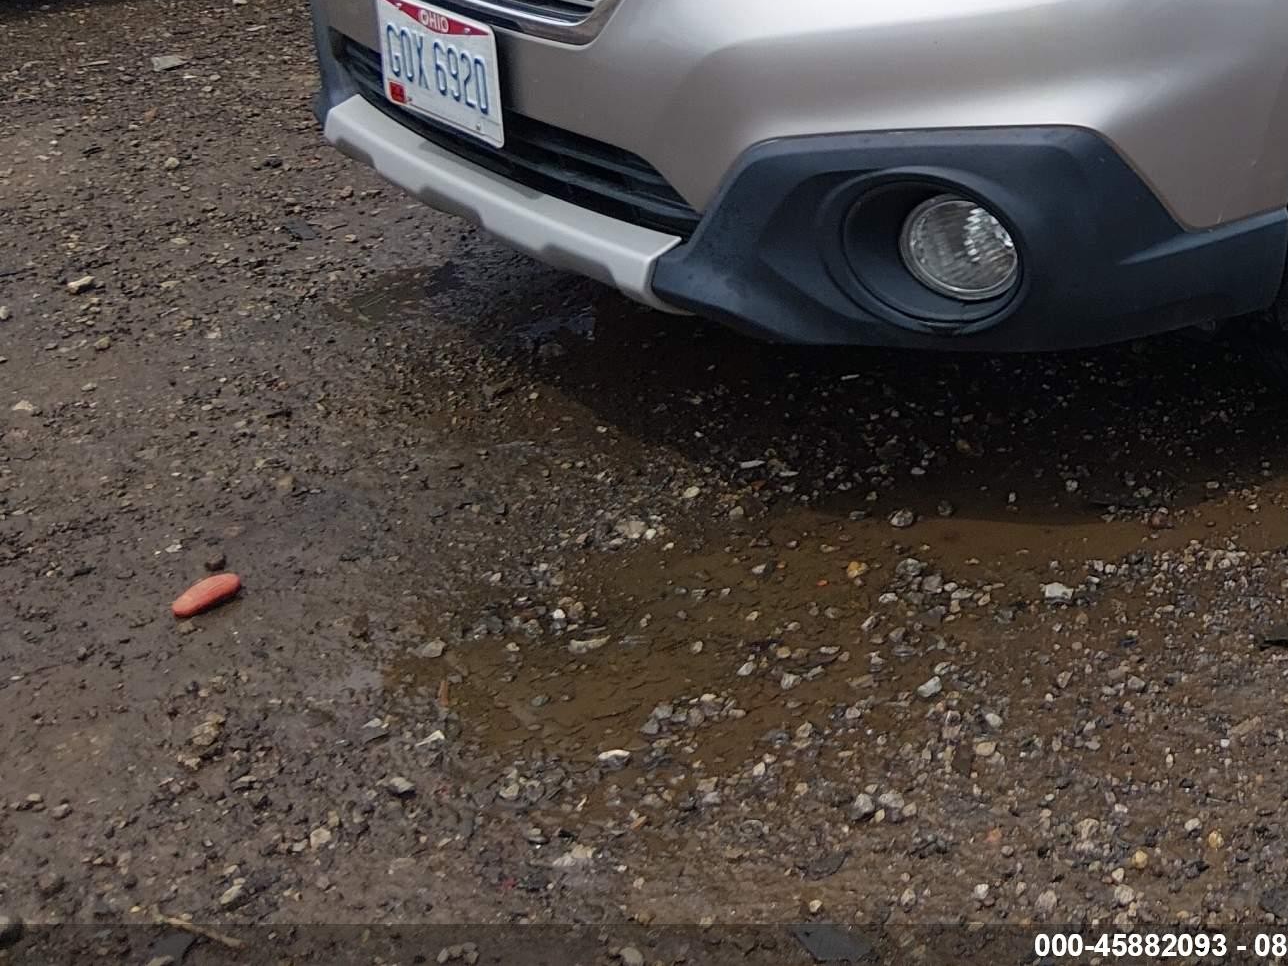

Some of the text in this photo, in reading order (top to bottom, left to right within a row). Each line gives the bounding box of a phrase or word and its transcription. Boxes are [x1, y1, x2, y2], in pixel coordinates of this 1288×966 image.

[418, 9, 450, 34] OHIO
[386, 21, 489, 116] GOX 6920
